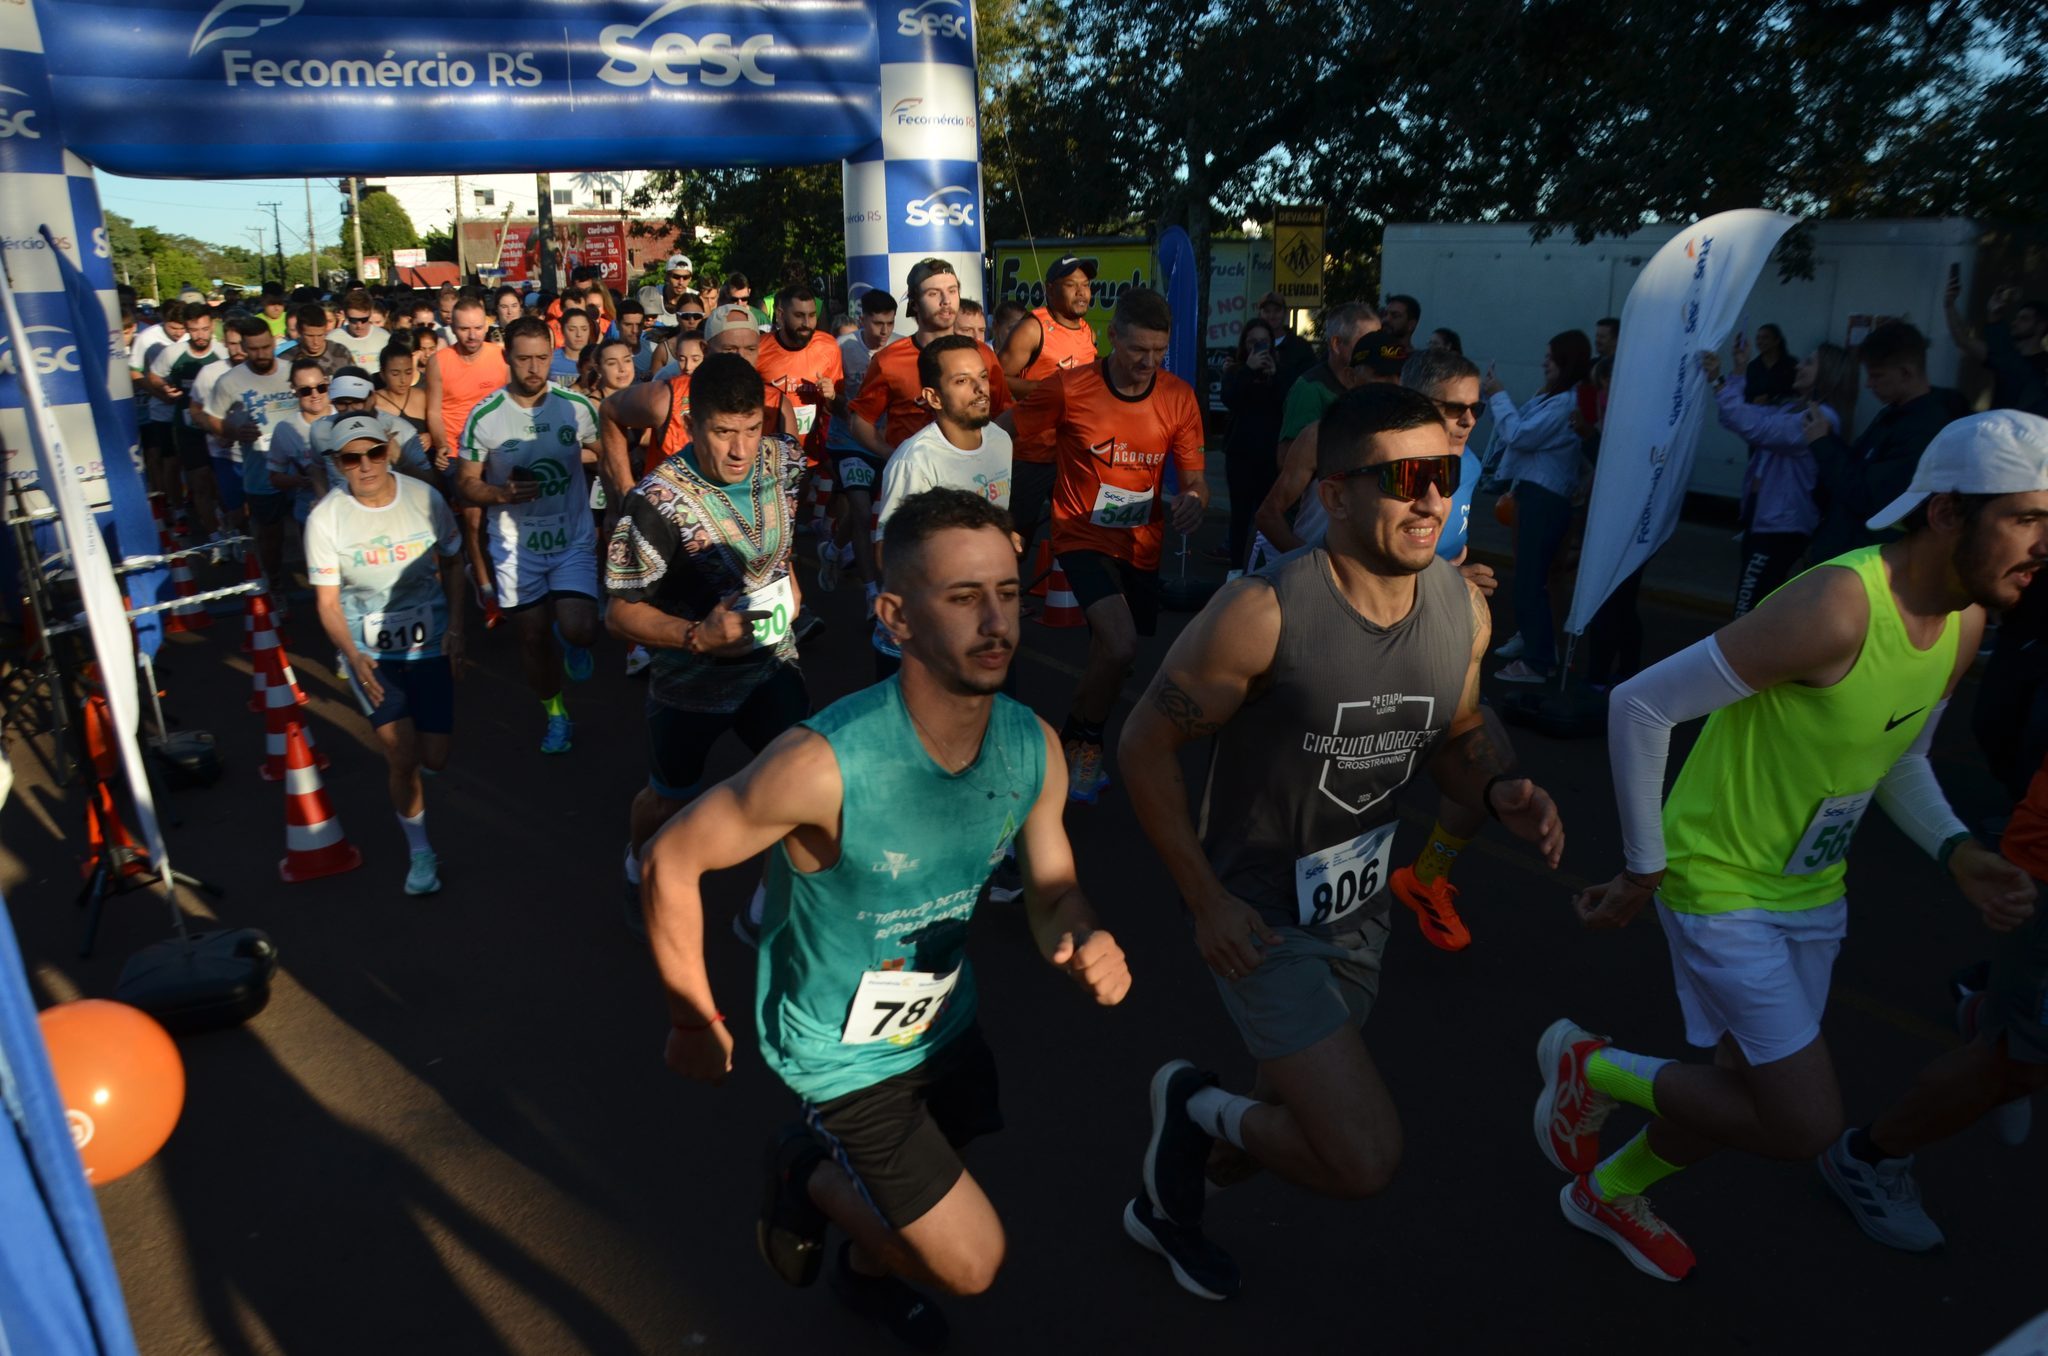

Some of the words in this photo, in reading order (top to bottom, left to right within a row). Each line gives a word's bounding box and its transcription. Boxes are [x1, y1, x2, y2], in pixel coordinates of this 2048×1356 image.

[222, 49, 476, 87] Fecomércio
[487, 52, 543, 87] RS
[0, 108, 41, 139] sc
[898, 113, 964, 126] Fecomércio
[867, 210, 882, 222] RS
[1279, 211, 1321, 223] DEVAGAR
[1001, 258, 1047, 308] Foo
[1278, 284, 1319, 296] ELEVADA
[1208, 320, 1242, 340] ETO
[1100, 503, 1147, 525] 544
[527, 527, 567, 552] 404
[377, 621, 425, 650] 810
[1381, 692, 1403, 706] ETAPA
[1302, 732, 1375, 756] CIRCUITO
[1337, 753, 1407, 770] CROSSTRAINING
[1804, 819, 1854, 868] 56
[1310, 858, 1380, 926] 806
